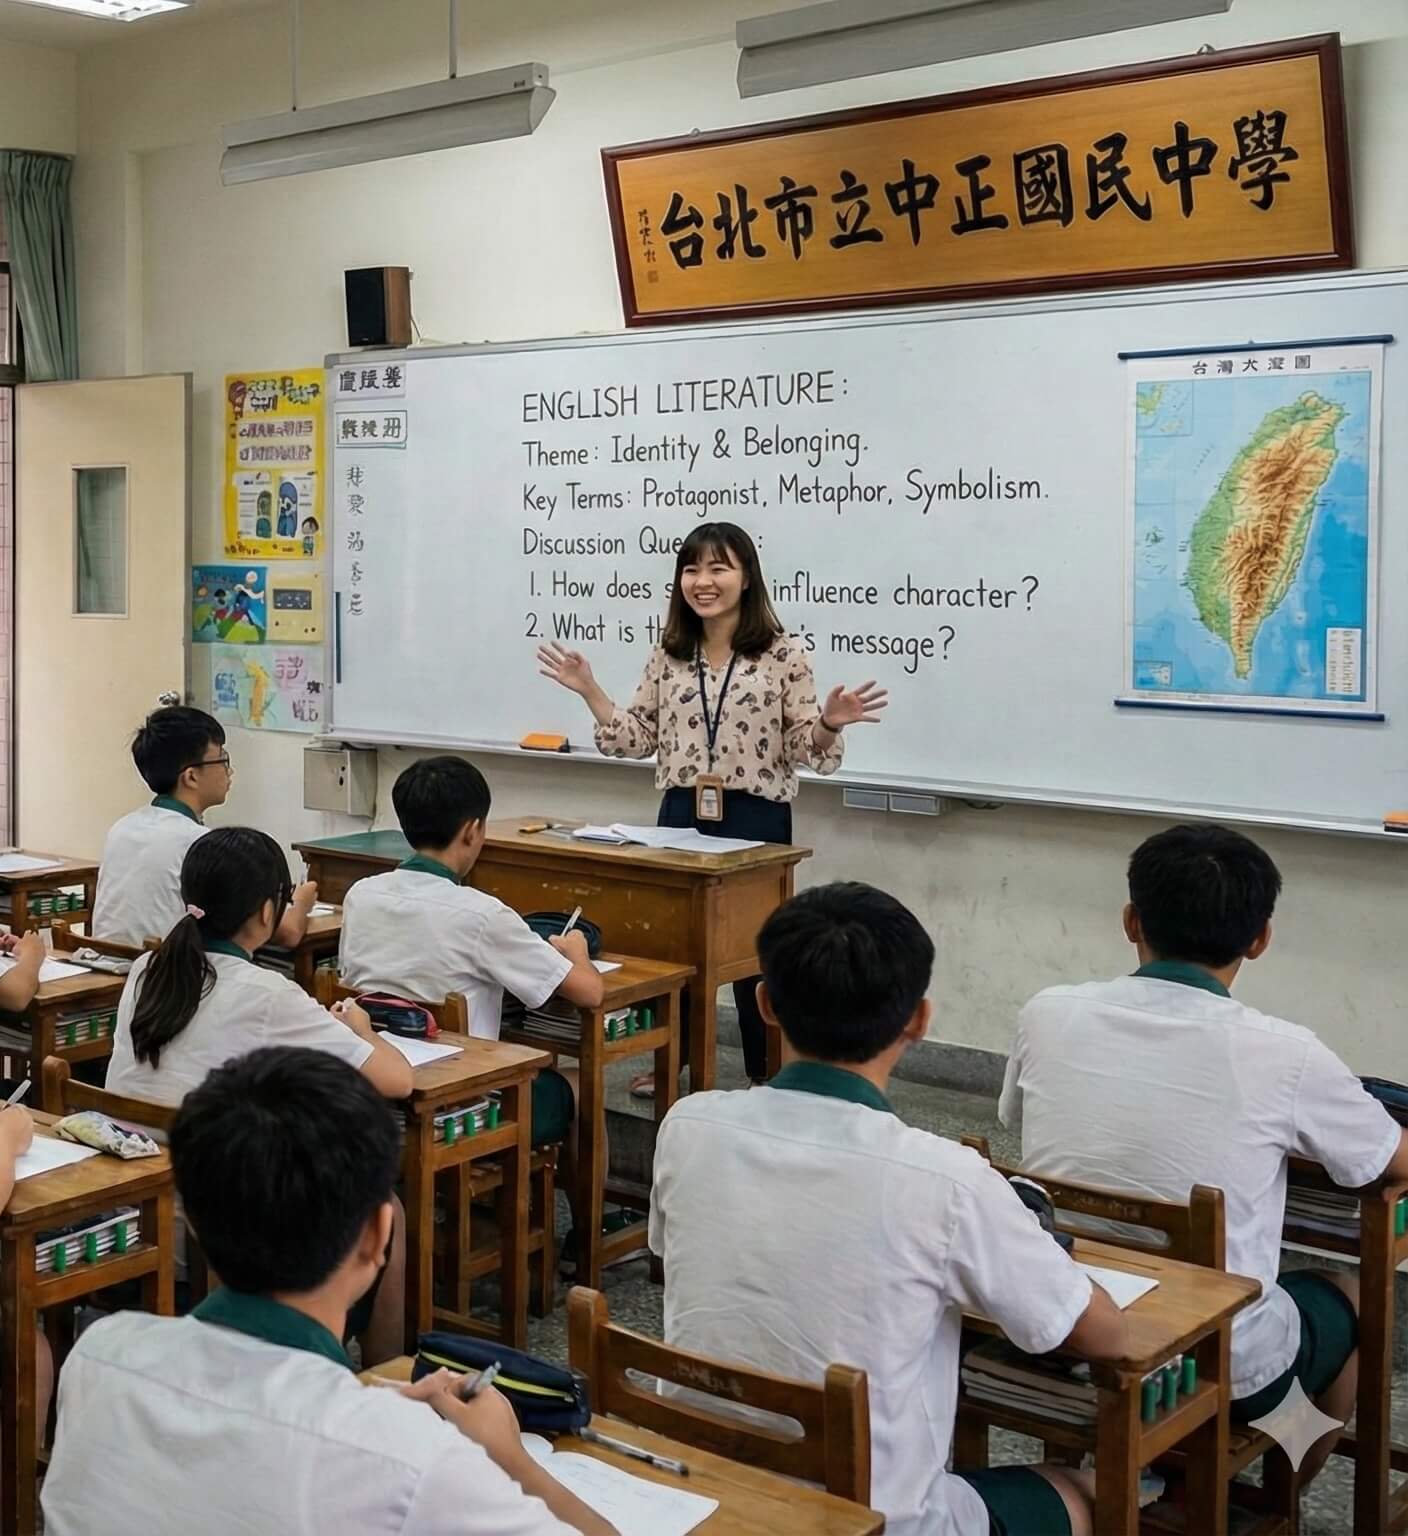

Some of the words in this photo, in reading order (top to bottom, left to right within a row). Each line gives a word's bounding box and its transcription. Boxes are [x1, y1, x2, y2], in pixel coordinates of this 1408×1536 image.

[661, 110, 1300, 269] 台北市立中正國民中學
[522, 384, 638, 423] ENGLISH
[656, 369, 848, 414] LITERATURE:
[521, 441, 599, 467] Theme:
[610, 433, 701, 473] Identity
[712, 428, 732, 459] &
[744, 423, 869, 468] Belonging.
[523, 483, 557, 521] Key
[566, 482, 631, 510] Terms:
[643, 478, 768, 518] Protagonist,
[779, 471, 893, 515] Metaphor,
[905, 466, 1049, 515] Symbolism.
[523, 527, 626, 556] Discussion
[530, 570, 542, 597] 1.
[552, 570, 595, 598] How
[606, 570, 652, 599] does
[773, 570, 878, 605] influence
[893, 573, 1040, 612] character?
[525, 612, 544, 638] 2.
[551, 612, 606, 643] What
[618, 619, 635, 644] is
[831, 625, 956, 674] message?
